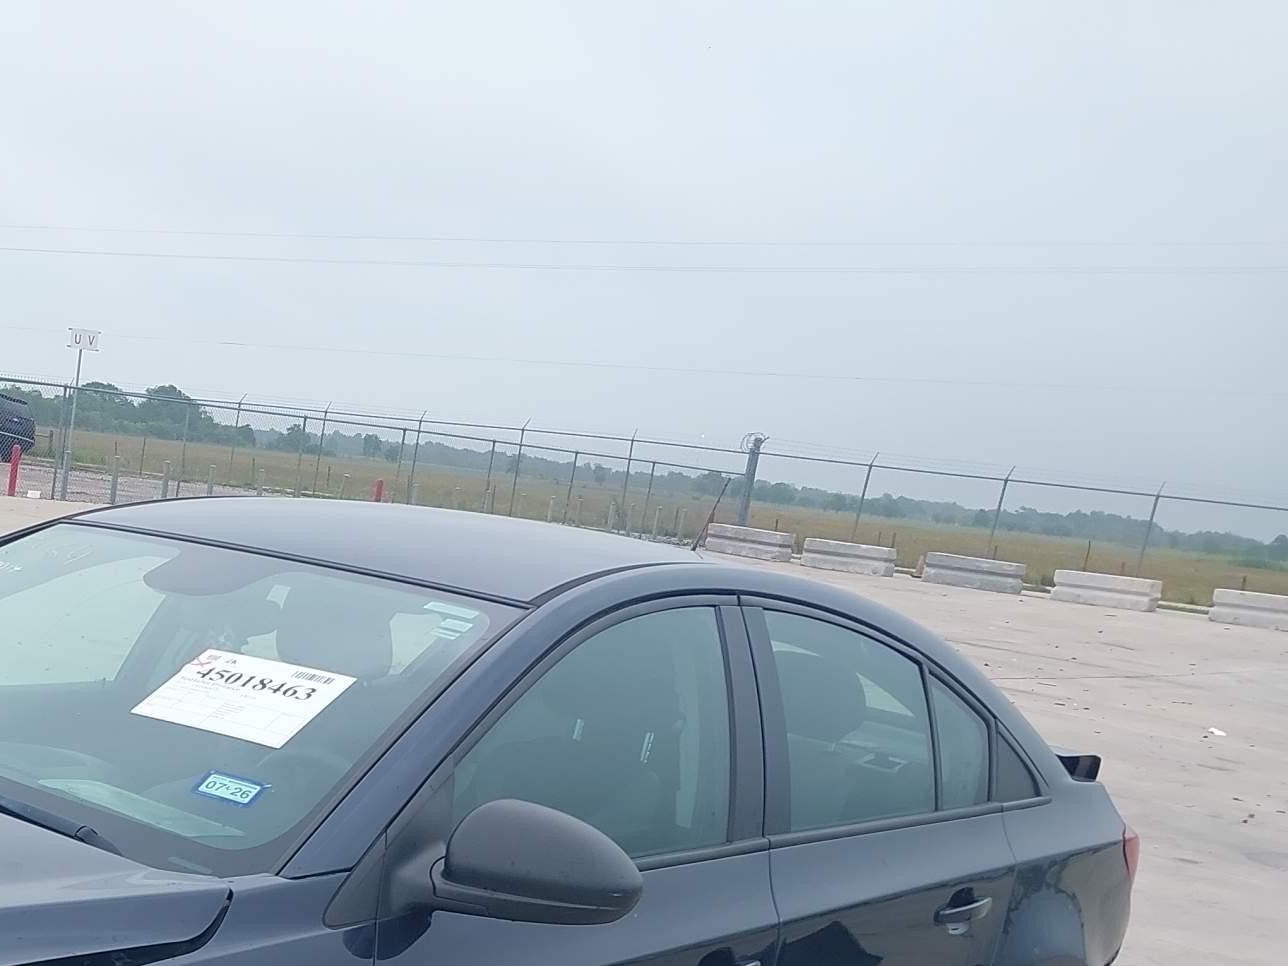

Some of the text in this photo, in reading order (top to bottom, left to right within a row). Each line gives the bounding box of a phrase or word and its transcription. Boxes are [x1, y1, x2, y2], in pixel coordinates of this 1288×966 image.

[74, 333, 96, 346] U V
[196, 667, 317, 701] 45018463
